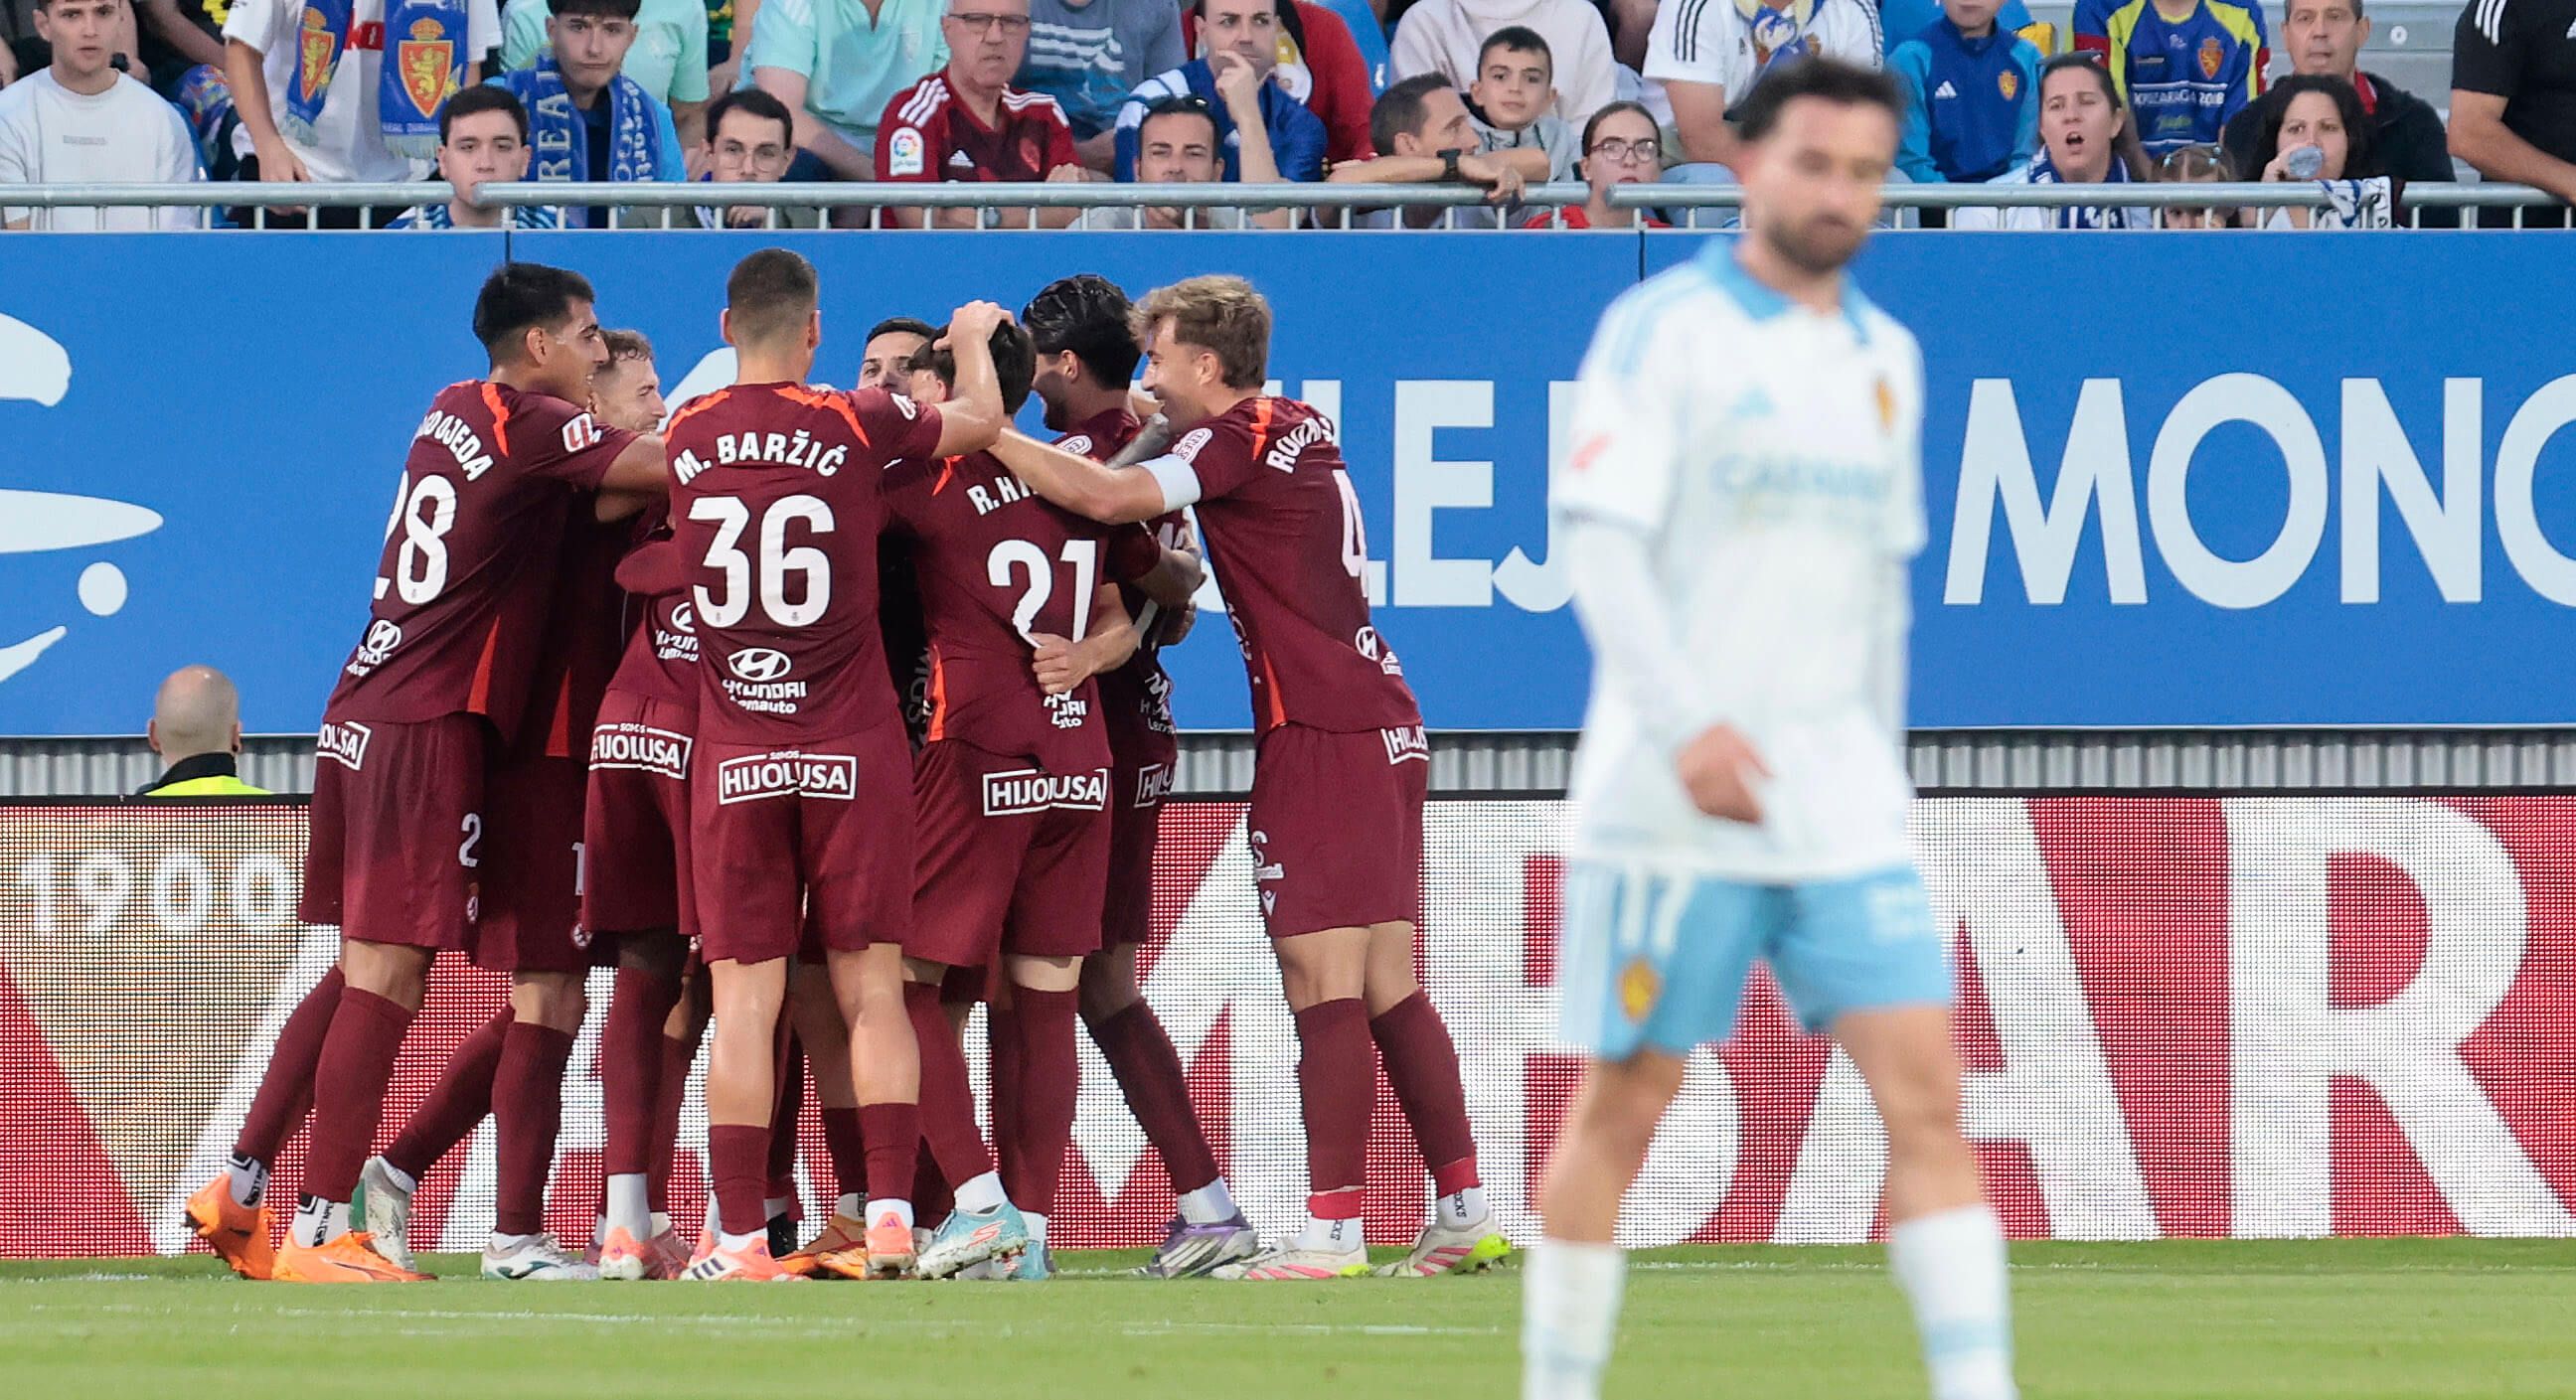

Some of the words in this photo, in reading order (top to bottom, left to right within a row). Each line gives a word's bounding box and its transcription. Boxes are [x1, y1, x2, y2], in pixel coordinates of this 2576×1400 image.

[673, 448, 712, 485] M.
[717, 428, 848, 477] BARŽIĆ
[687, 494, 835, 628] 36
[987, 539, 1096, 649] 21
[724, 761, 849, 796] HIJOLUSA
[20, 851, 299, 936] 1900
